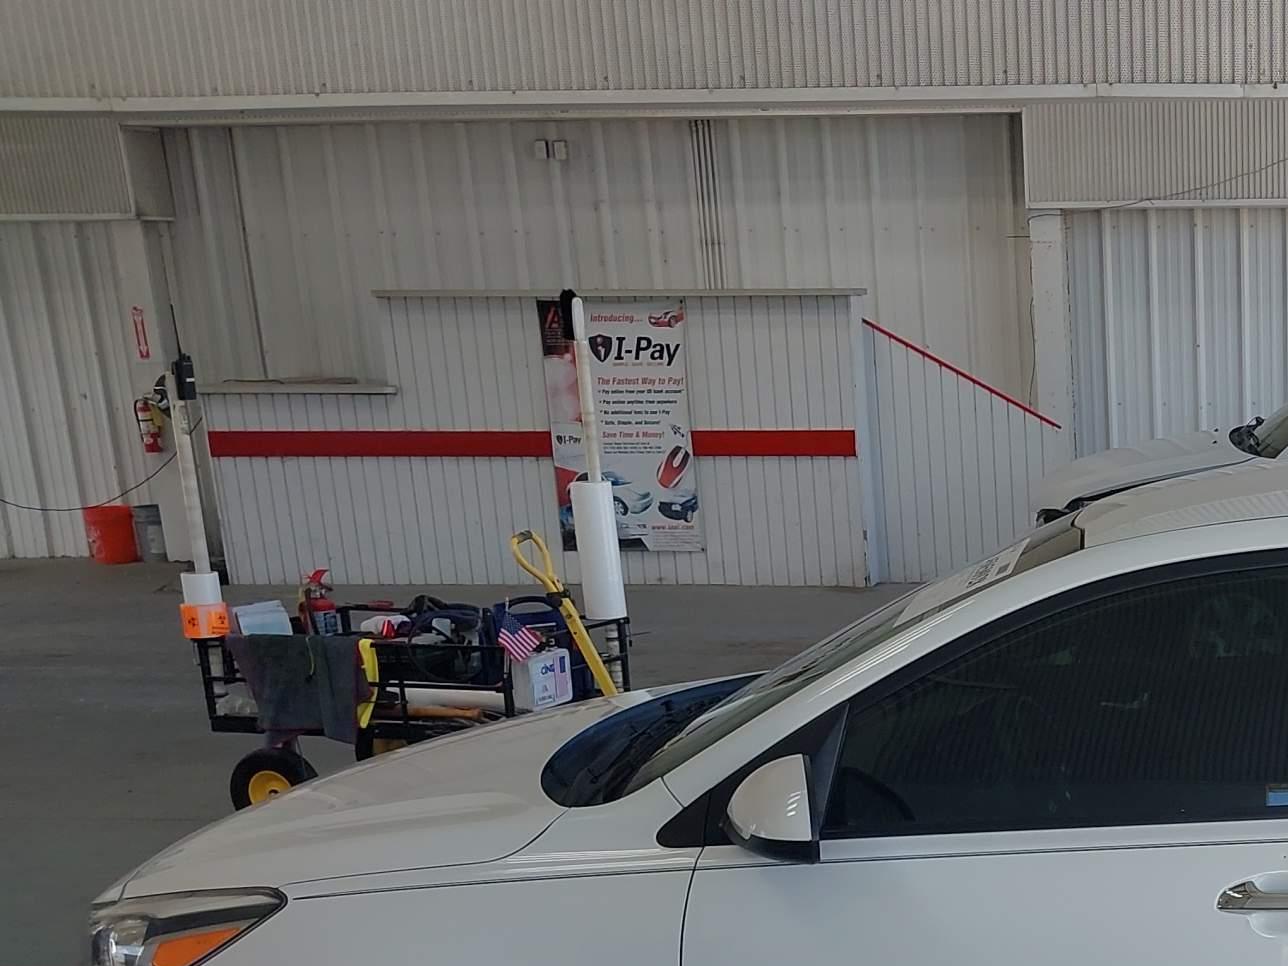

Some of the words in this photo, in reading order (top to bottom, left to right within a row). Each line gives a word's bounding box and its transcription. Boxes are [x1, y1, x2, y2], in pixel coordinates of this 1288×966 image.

[614, 336, 681, 367] I-Pay
[597, 377, 610, 386] The
[612, 377, 639, 386] Fastest
[641, 377, 656, 388] Way
[658, 377, 666, 386] to
[668, 376, 684, 388] Pay!
[602, 431, 618, 439] Save
[620, 431, 635, 439] Time
